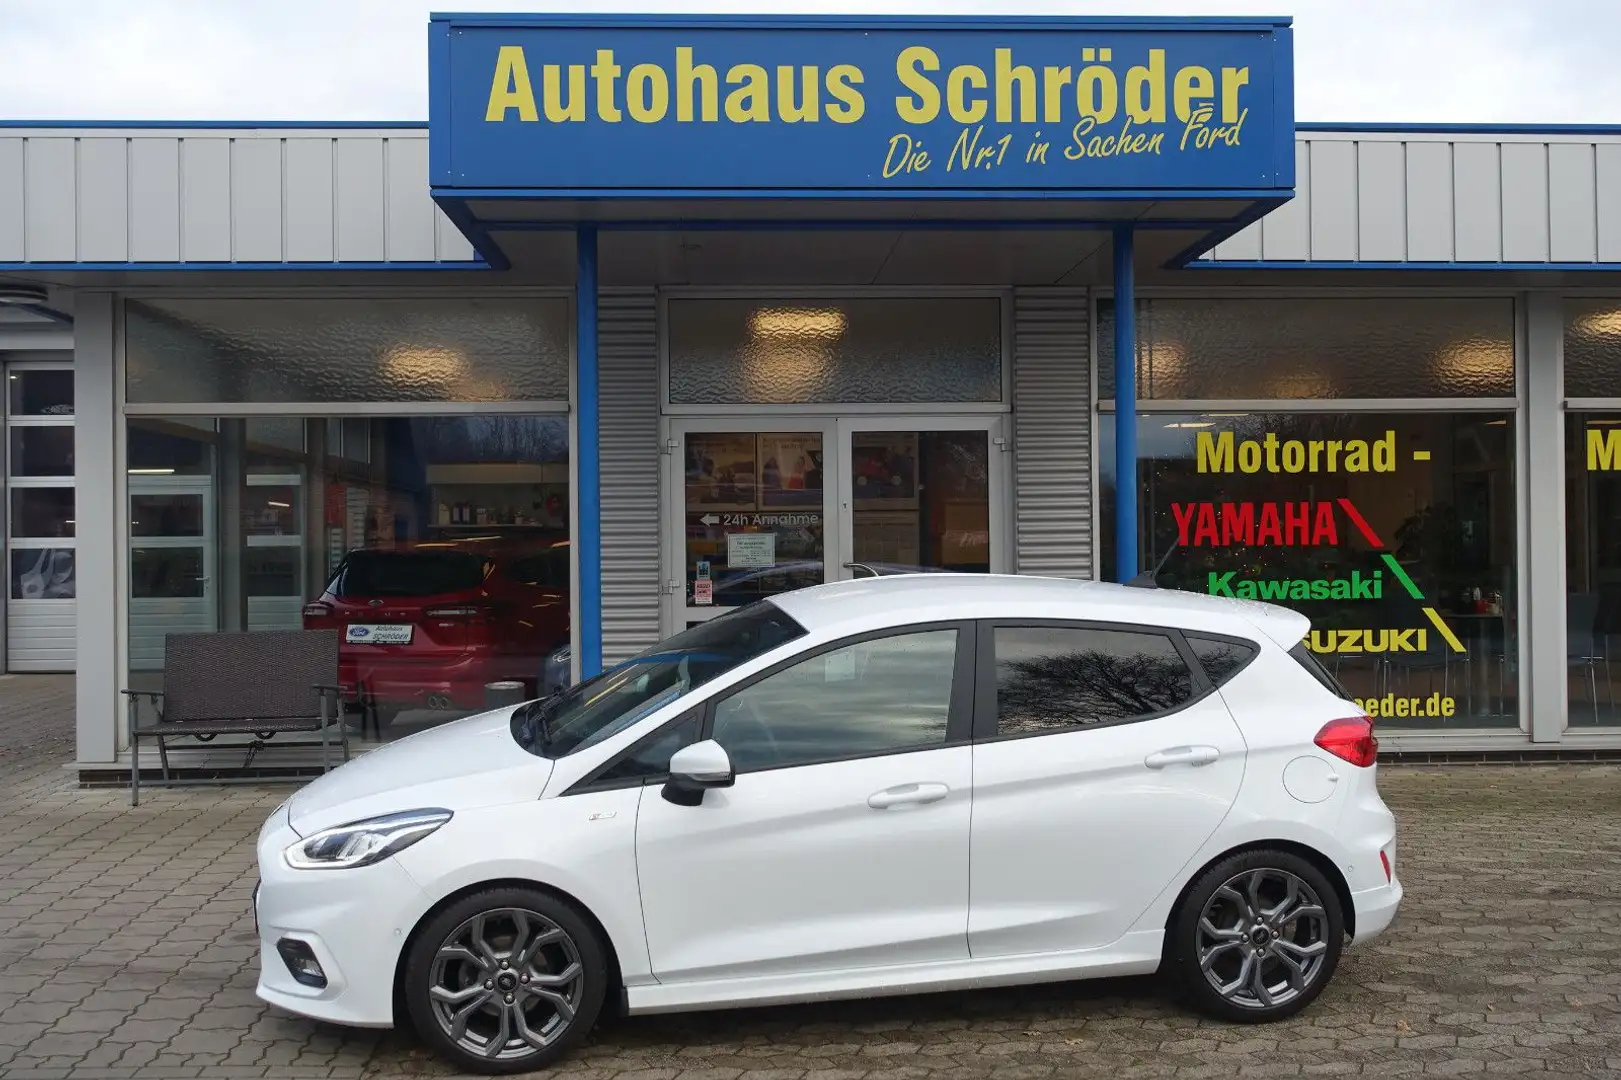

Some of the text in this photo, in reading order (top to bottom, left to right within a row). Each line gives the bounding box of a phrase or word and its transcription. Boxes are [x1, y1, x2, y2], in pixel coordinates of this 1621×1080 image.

[485, 45, 1249, 124] Autohaus Schröder
[882, 133, 931, 179] Die
[1025, 130, 1047, 165] in
[1064, 114, 1165, 161] Sachen
[1180, 104, 1249, 150] Ford
[1196, 430, 1396, 474] Motorrad
[723, 512, 819, 526] 24h Annahme
[1170, 501, 1338, 547] YAMAHA
[1207, 569, 1383, 600] Kawasaki
